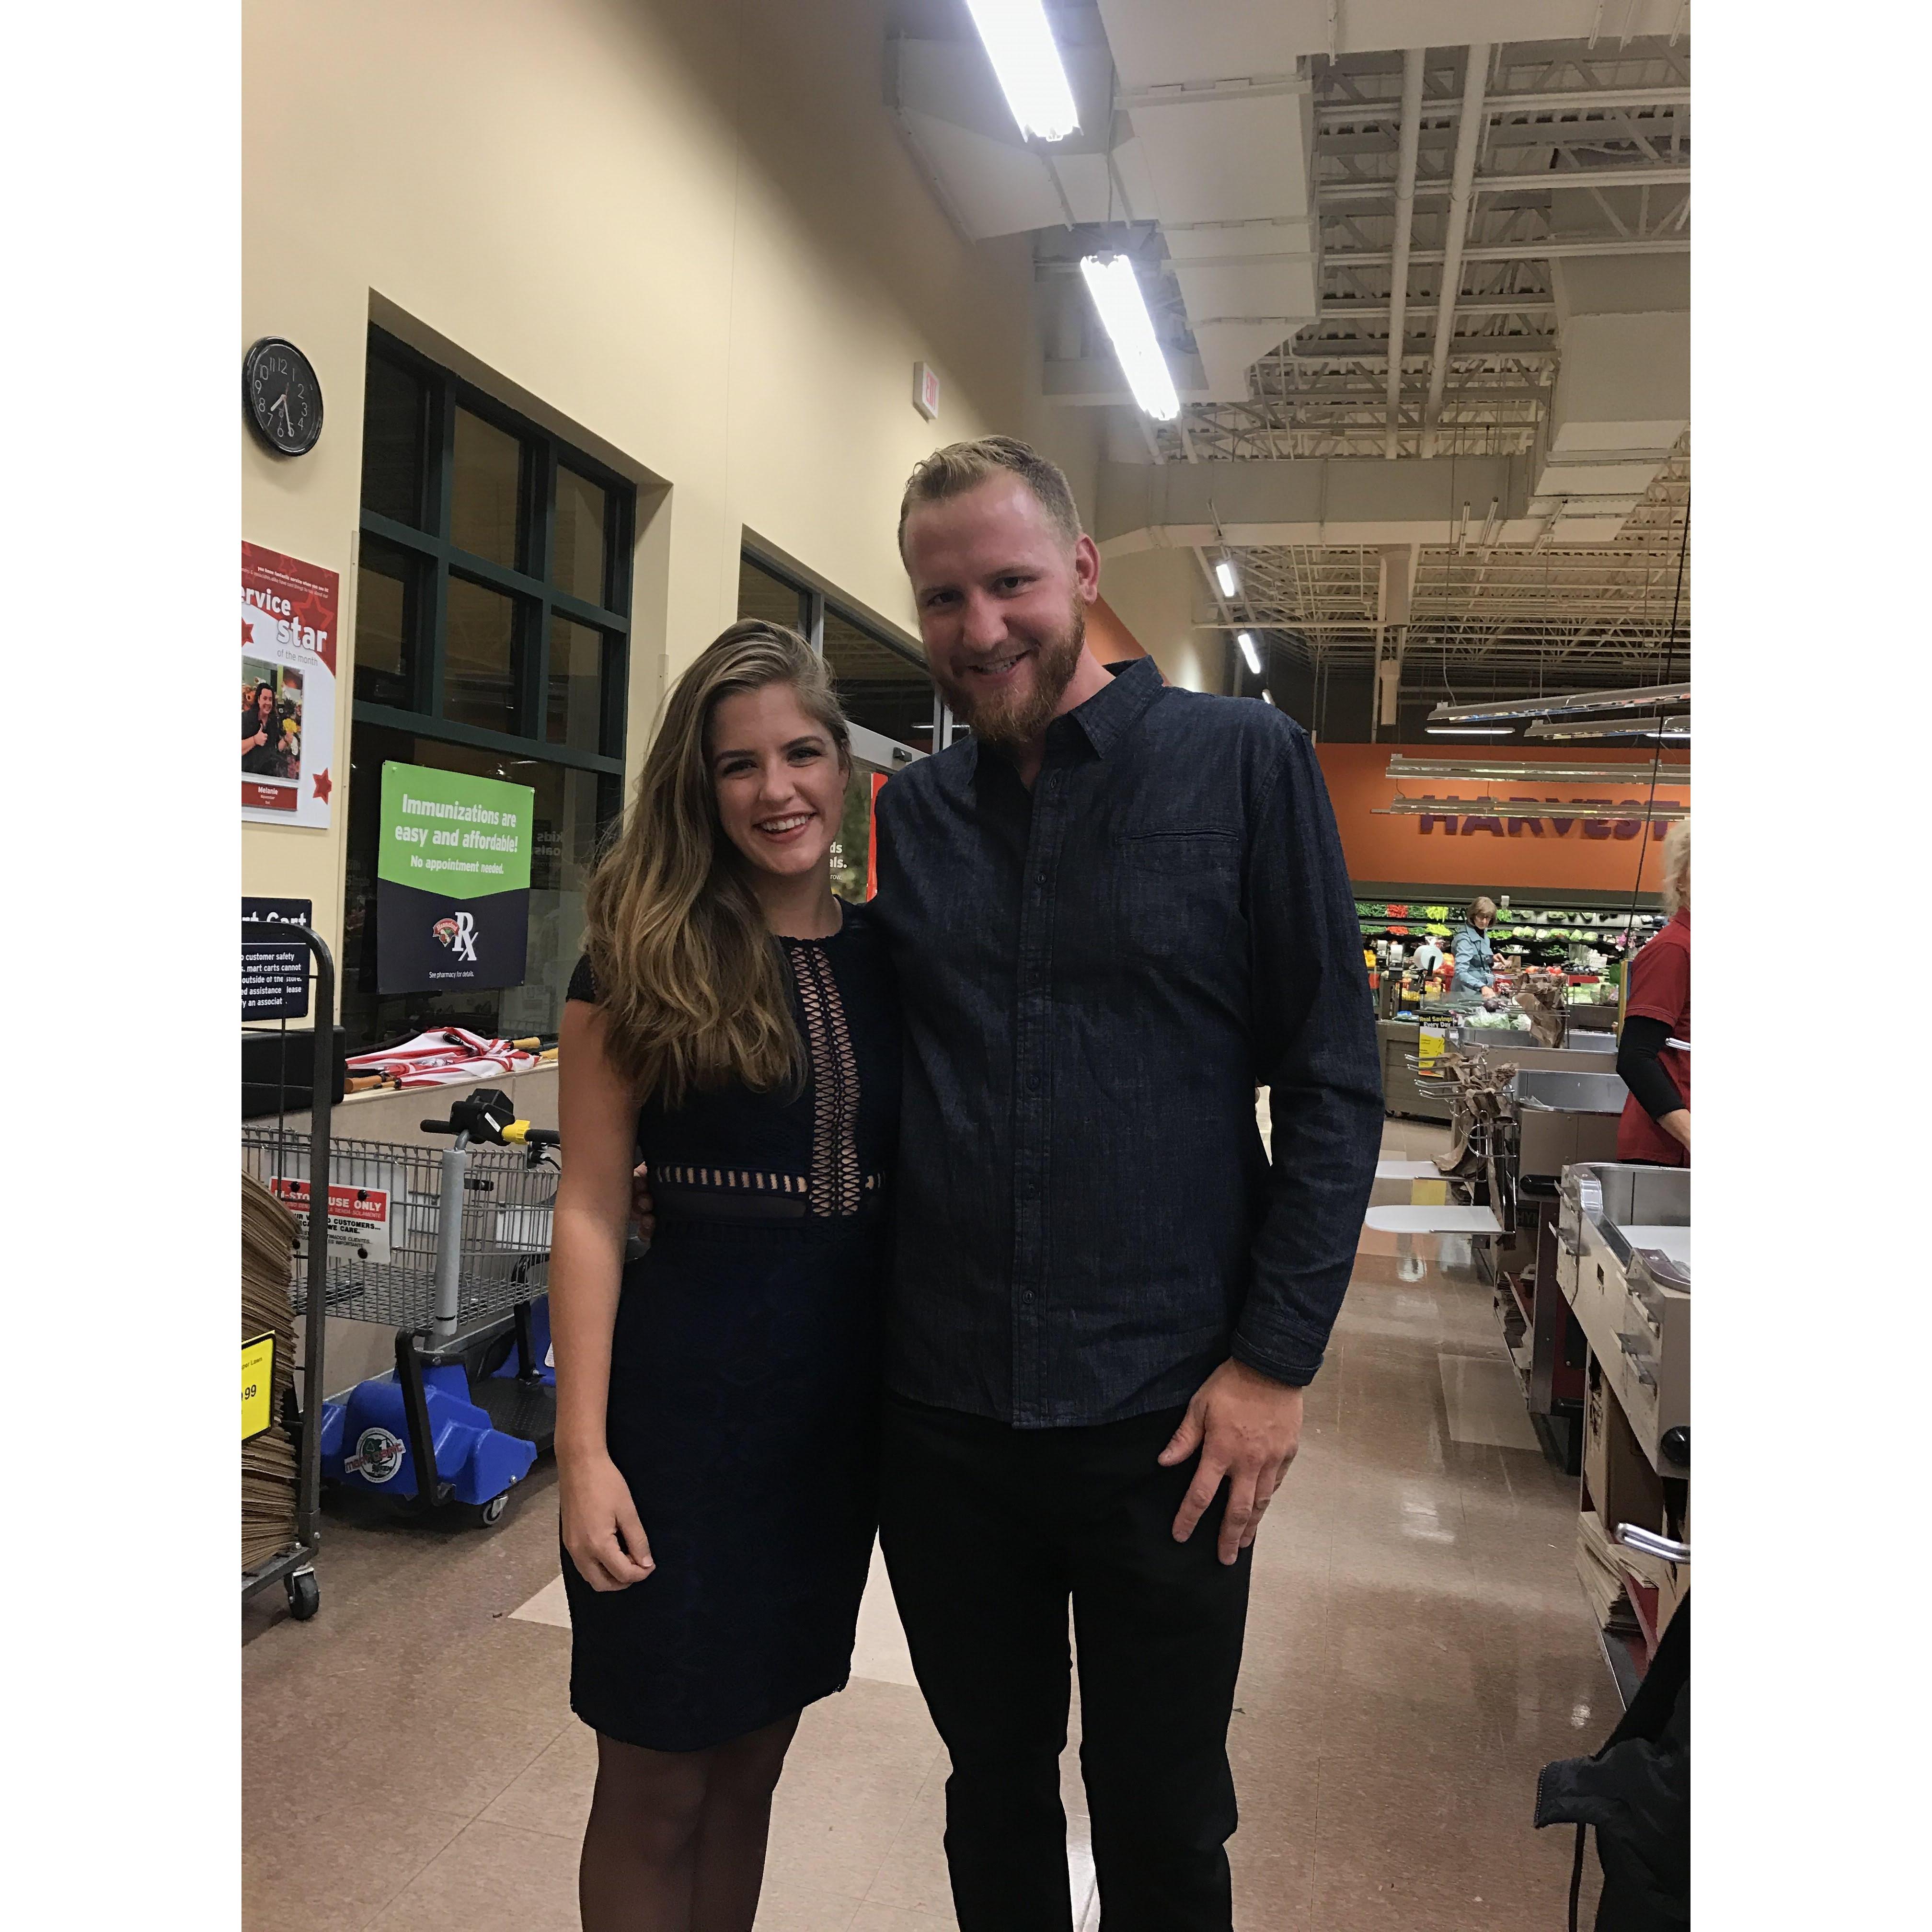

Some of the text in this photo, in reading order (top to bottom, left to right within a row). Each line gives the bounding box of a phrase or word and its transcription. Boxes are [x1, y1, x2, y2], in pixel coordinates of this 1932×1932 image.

[270, 357, 275, 372] 11
[278, 357, 287, 375] 12
[260, 365, 268, 380] 10
[255, 380, 262, 394] 9
[298, 384, 304, 399] 2
[259, 398, 265, 412] 8
[301, 402, 308, 416] 3
[267, 412, 273, 426] 7
[298, 418, 304, 431] 4
[277, 422, 284, 437] 6
[277, 616, 327, 652] star
[277, 649, 318, 667] of the month
[402, 794, 517, 828] Immunizations are
[395, 825, 518, 853] easy and affordable!
[411, 855, 504, 874] No appointment needed.
[246, 953, 275, 961] customer
[276, 952, 295, 961] safety
[247, 964, 262, 972] mart
[264, 964, 279, 972] carts
[242, 975, 265, 984] outside
[249, 986, 282, 995] assistance
[286, 985, 302, 993] lease
[257, 997, 288, 1006] associat.
[328, 1196, 349, 1208] USE
[354, 1200, 382, 1212] ONLY
[340, 1226, 360, 1234] CARE.
[251, 1357, 263, 1366] Lawn
